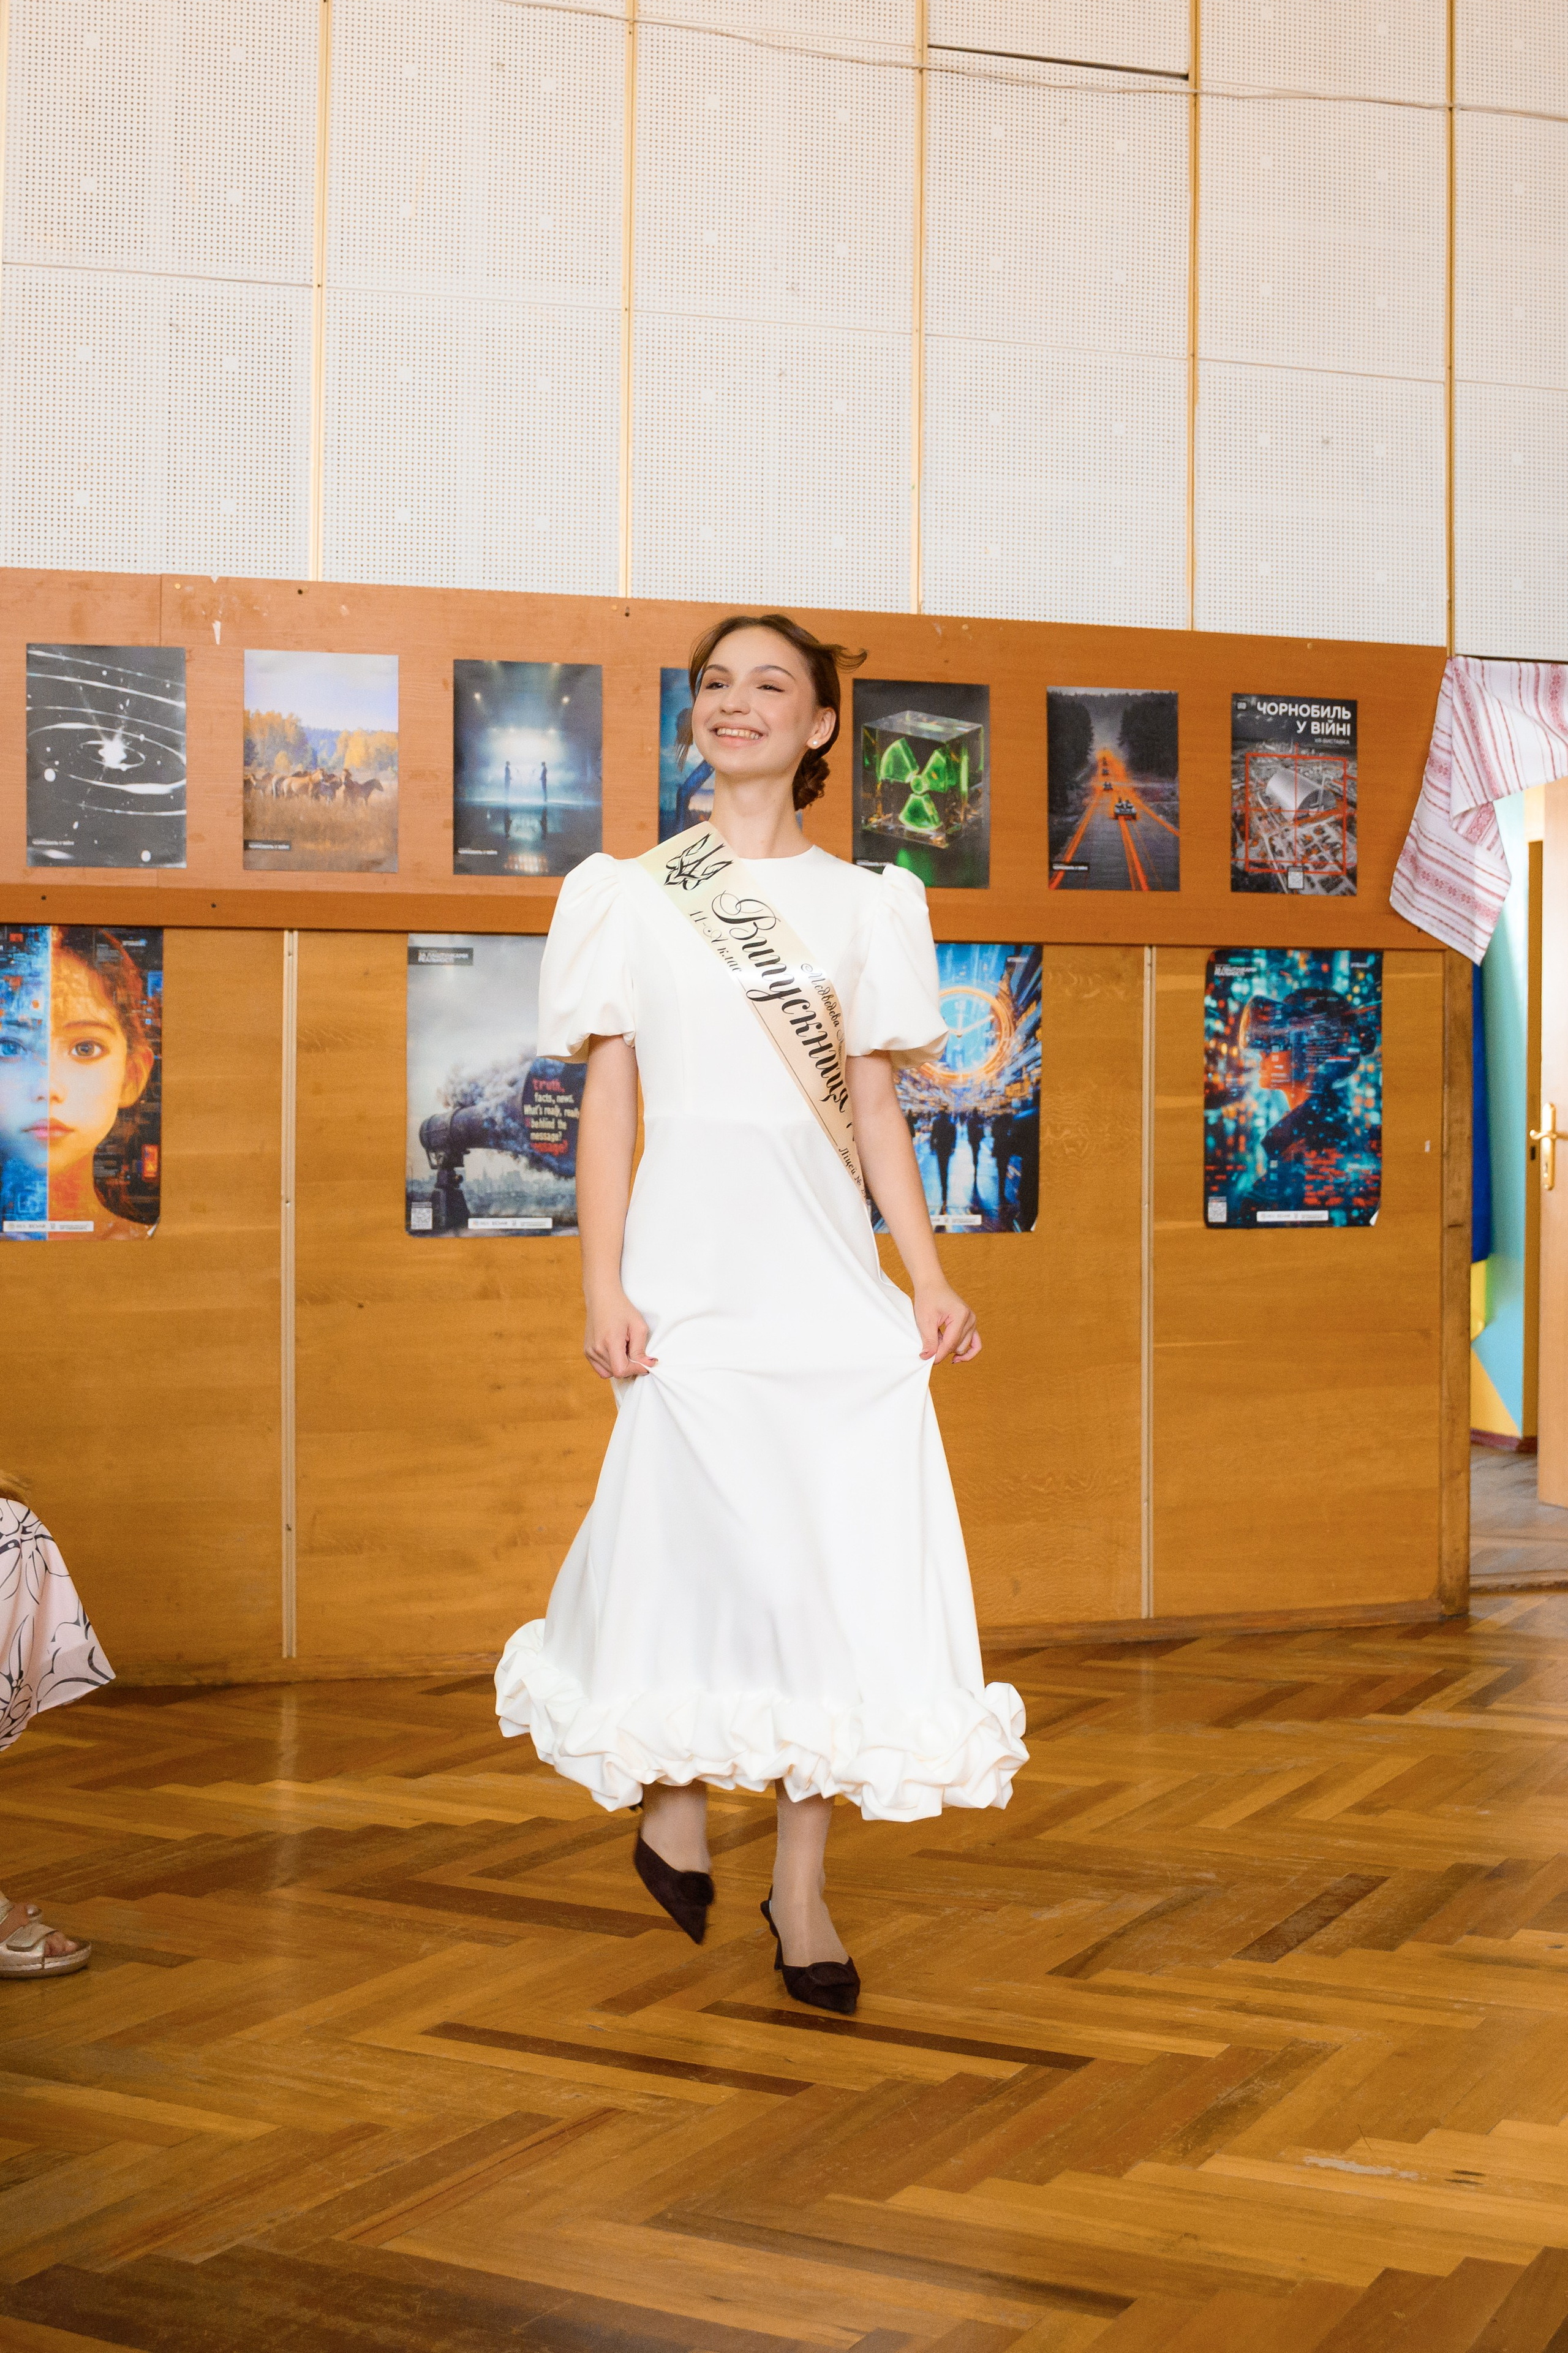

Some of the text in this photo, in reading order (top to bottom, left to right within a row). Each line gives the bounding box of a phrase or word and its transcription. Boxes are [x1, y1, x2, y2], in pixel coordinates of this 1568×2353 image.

[1257, 701, 1351, 720] ЧОРНОБИЛЬ
[1296, 719, 1351, 736] У ВІЙНІ
[711, 890, 850, 1113] Випускниця
[839, 1147, 858, 1175] Ліцей
